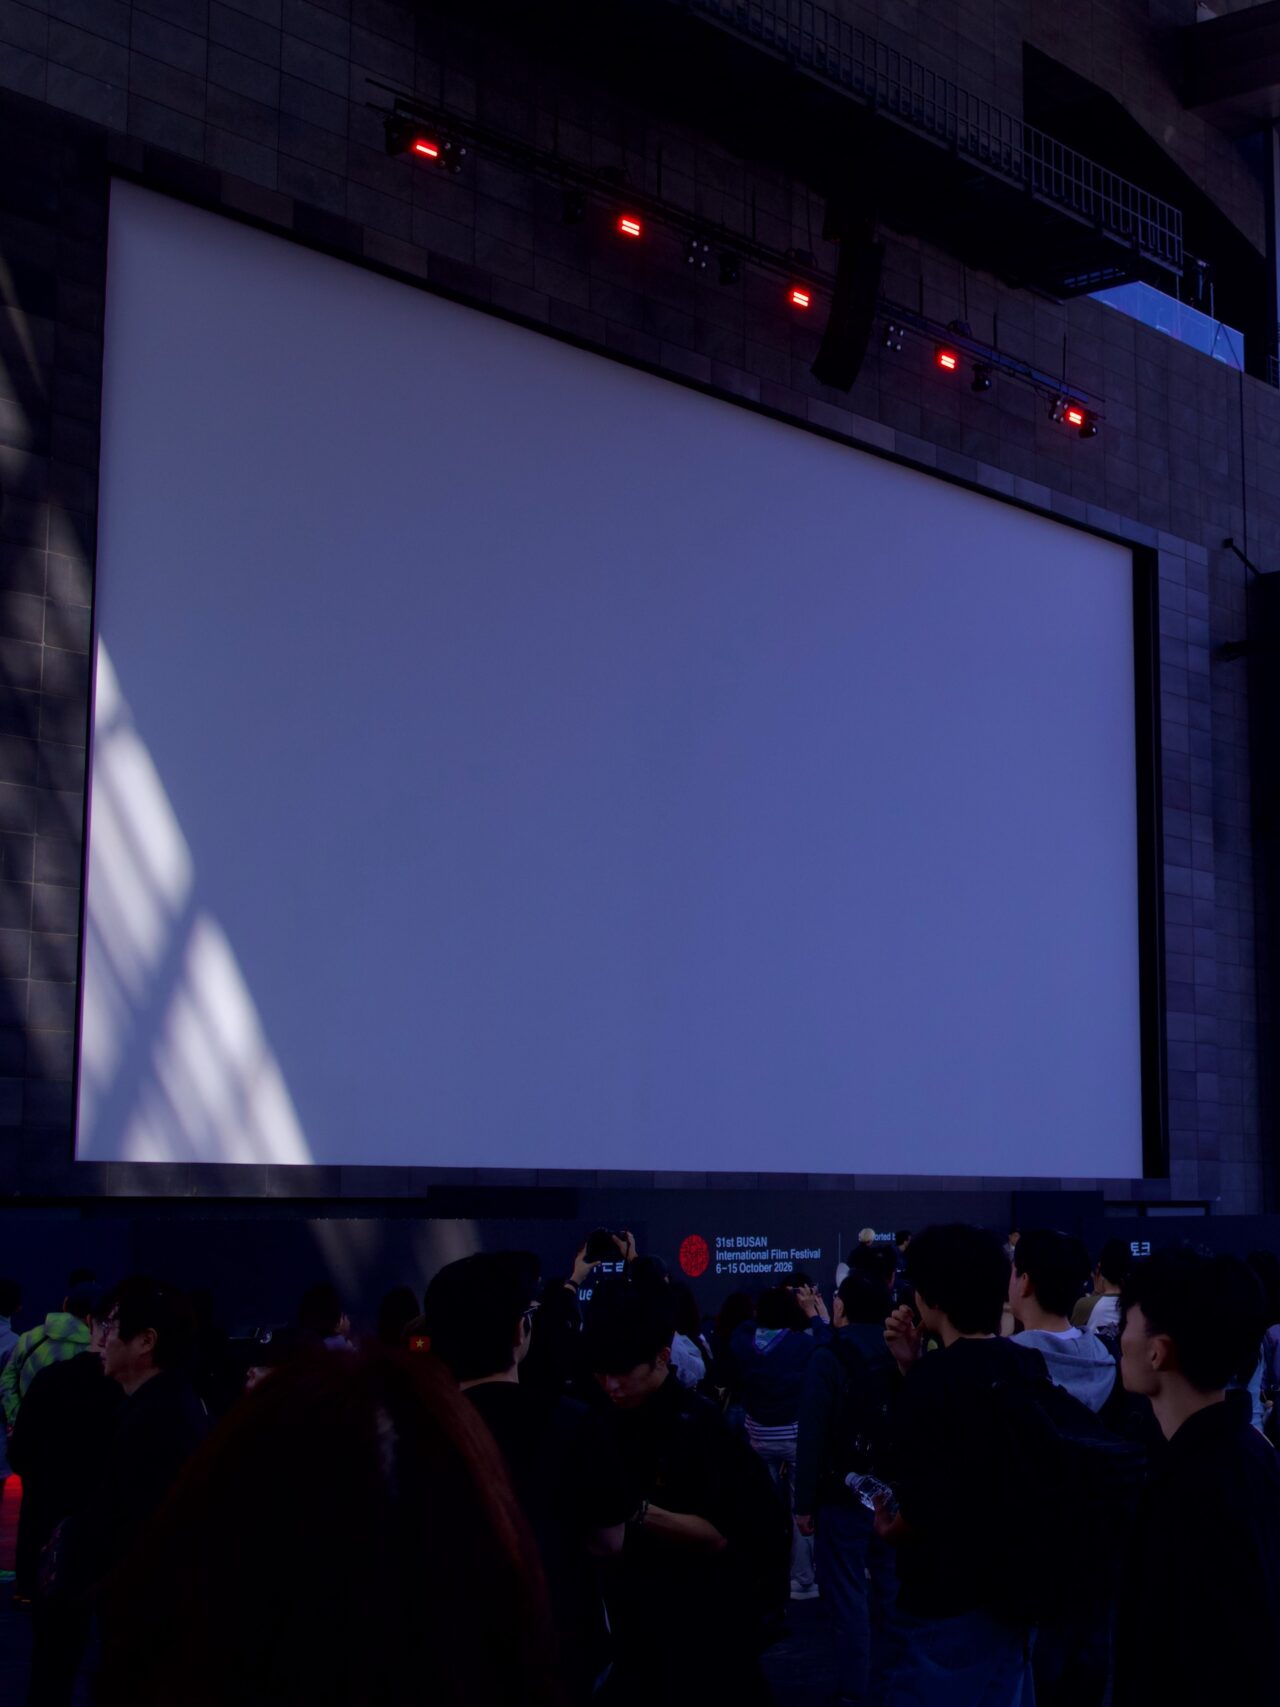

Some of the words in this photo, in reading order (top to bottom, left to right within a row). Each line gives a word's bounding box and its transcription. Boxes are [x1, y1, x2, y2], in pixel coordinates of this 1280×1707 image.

[716, 1236, 735, 1248] 31st
[736, 1236, 768, 1247] BUSAN
[715, 1248, 769, 1260] International
[770, 1248, 788, 1260] Film
[789, 1247, 821, 1259] Festival
[1130, 1241, 1152, 1257] 토크
[738, 1262, 773, 1274] October
[774, 1261, 793, 1273] 2026
